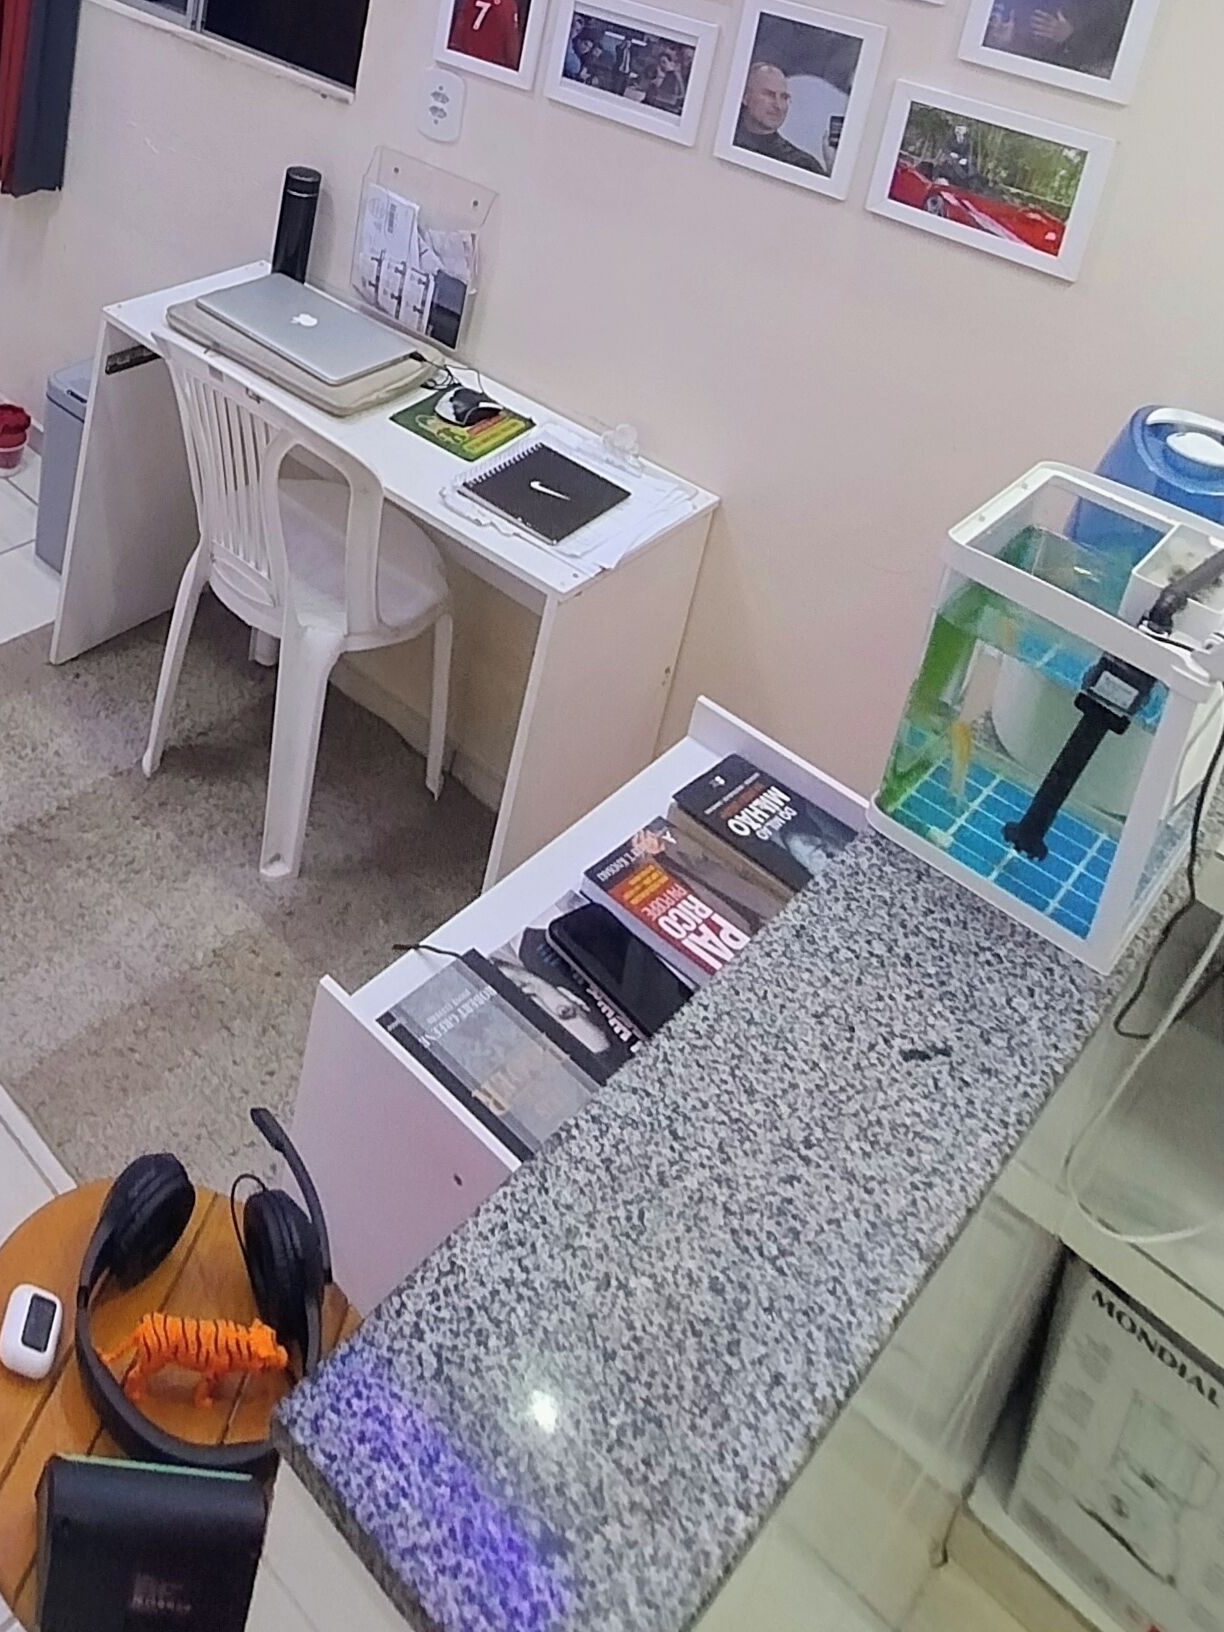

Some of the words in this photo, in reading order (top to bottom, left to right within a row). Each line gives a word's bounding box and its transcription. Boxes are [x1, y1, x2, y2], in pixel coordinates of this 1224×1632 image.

[472, 0, 491, 30] 7
[778, 806, 797, 821] DO
[657, 894, 714, 940] RICO
[681, 913, 751, 971] PAI
[1092, 1289, 1220, 1409] MONDIAL
